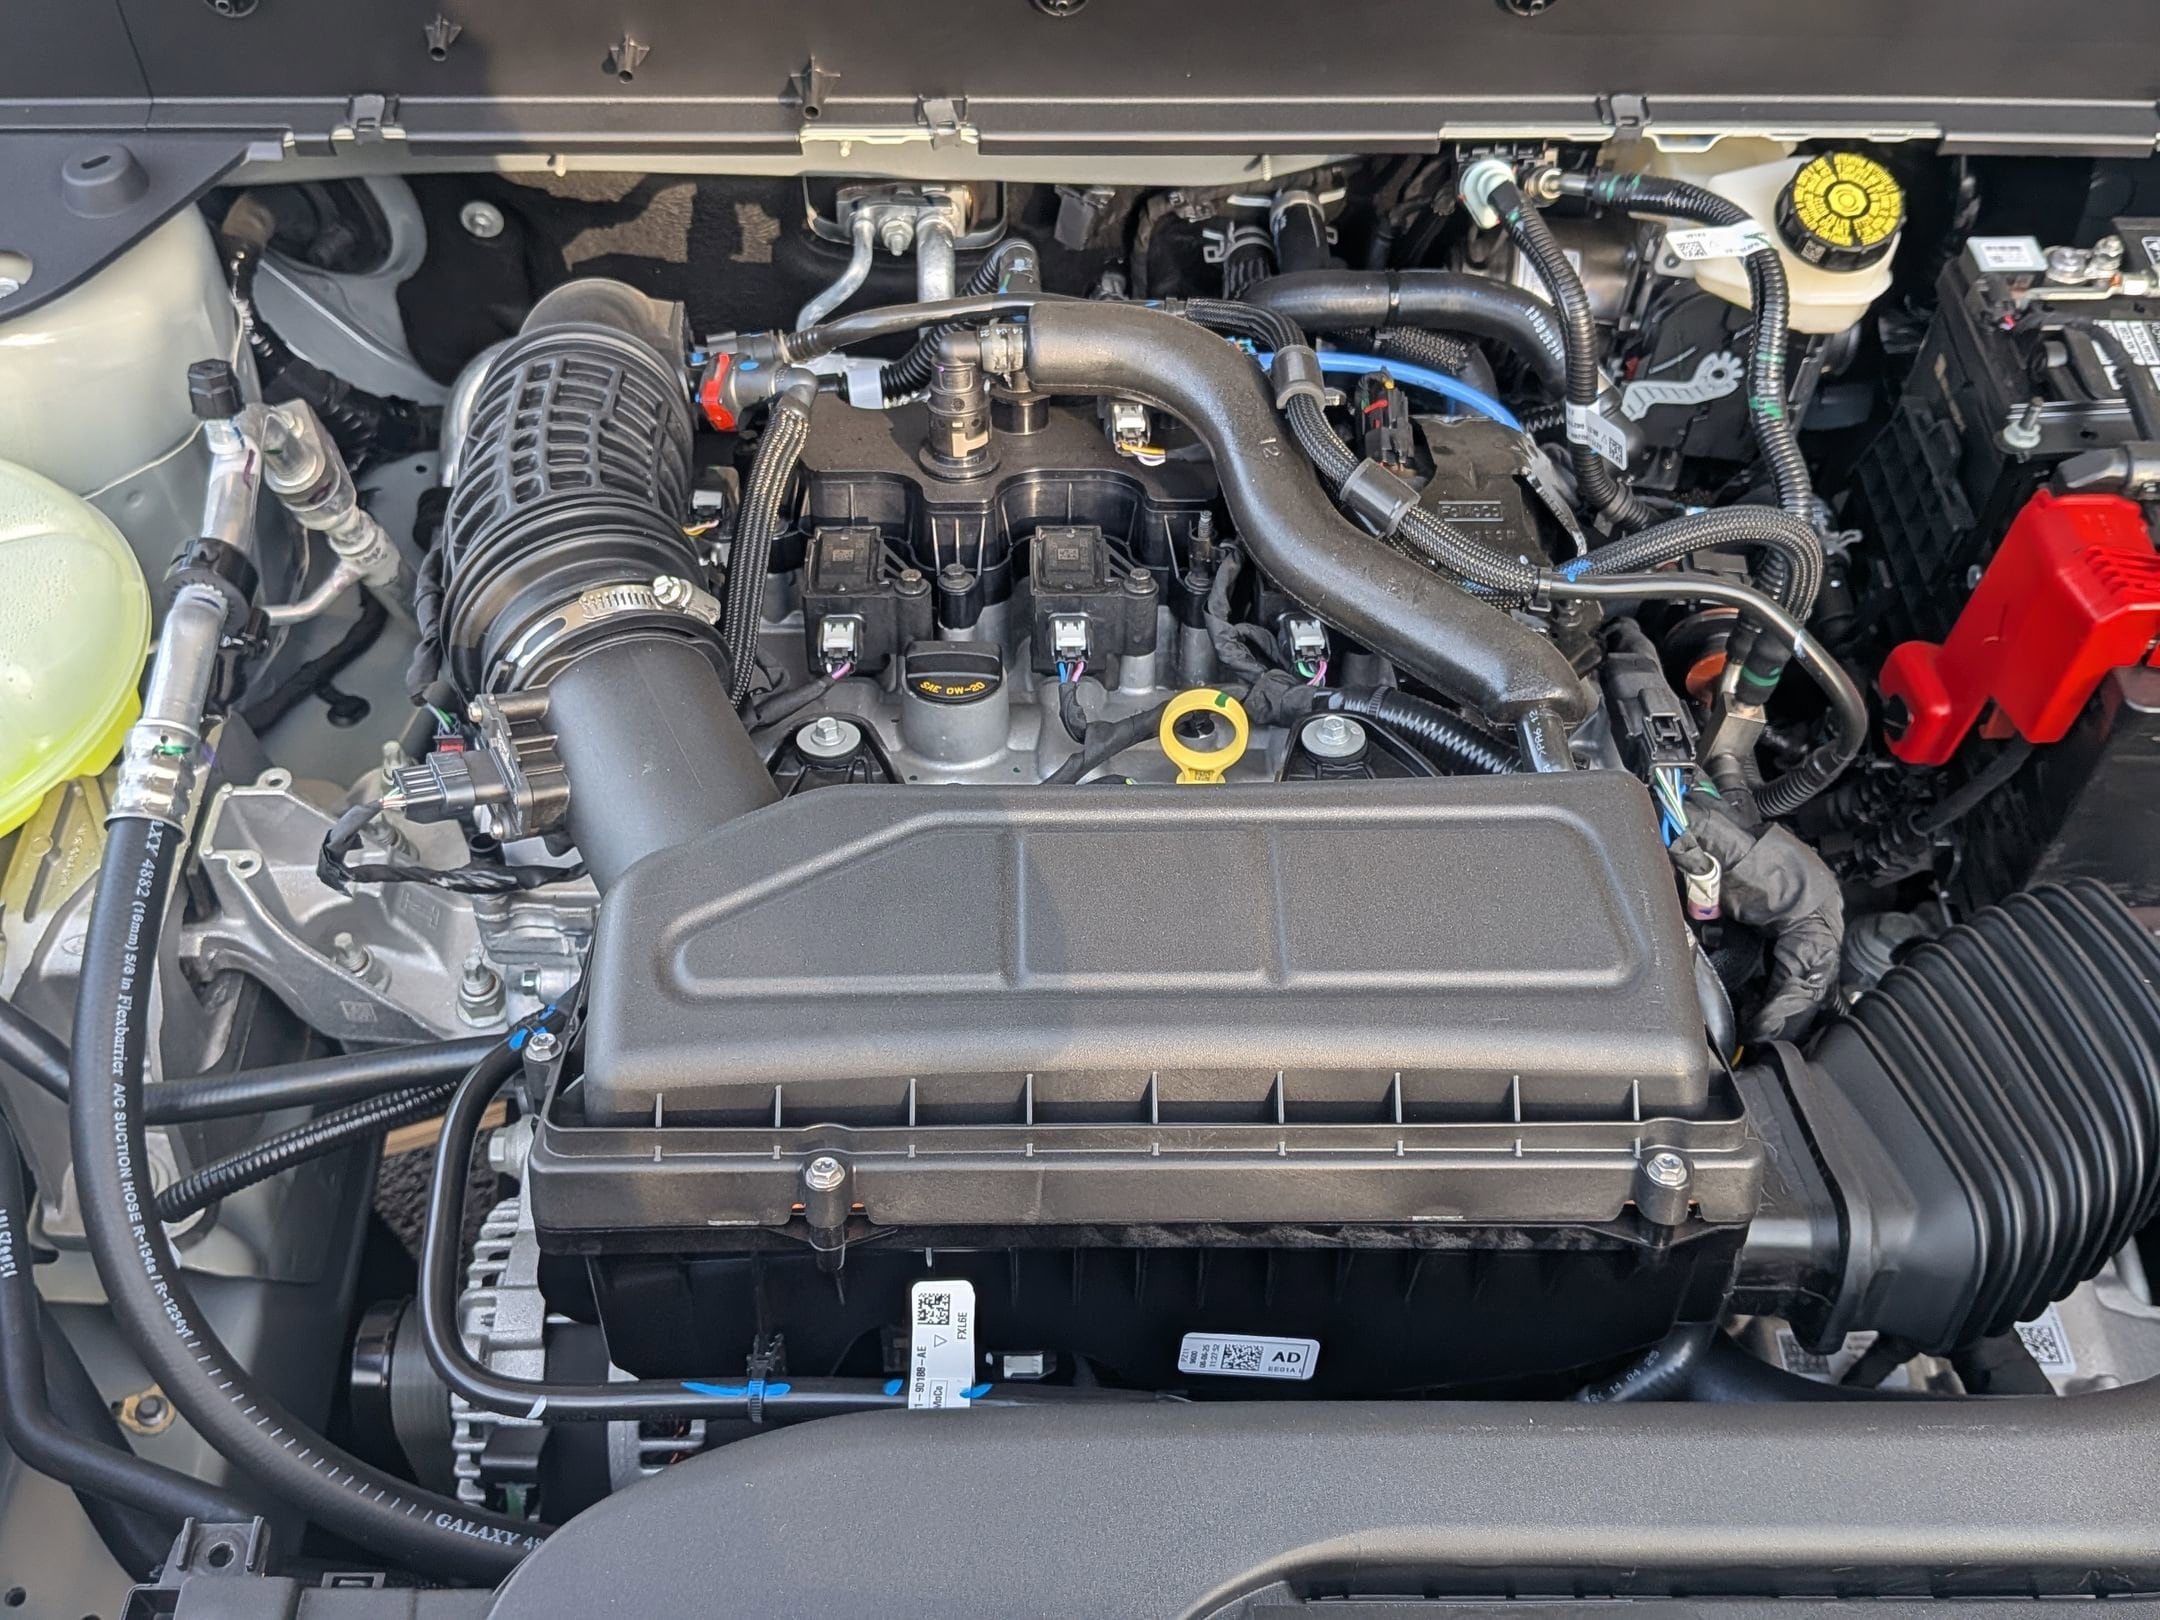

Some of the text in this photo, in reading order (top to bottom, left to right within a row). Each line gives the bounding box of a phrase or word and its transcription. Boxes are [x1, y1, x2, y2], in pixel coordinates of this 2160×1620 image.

[920, 681, 986, 695] SAE 0W-20
[136, 858, 155, 897] 4882
[124, 900, 146, 951] (16mm)
[123, 953, 138, 976] 5/8
[112, 993, 133, 1077] Flexbarrier
[113, 1082, 126, 1108] A/C
[114, 1111, 133, 1179] SUCTION
[122, 1180, 142, 1223] HOSE
[956, 1311, 968, 1340] FXL6E
[1271, 1351, 1301, 1363] AD
[435, 1513, 521, 1546] GALAXY
